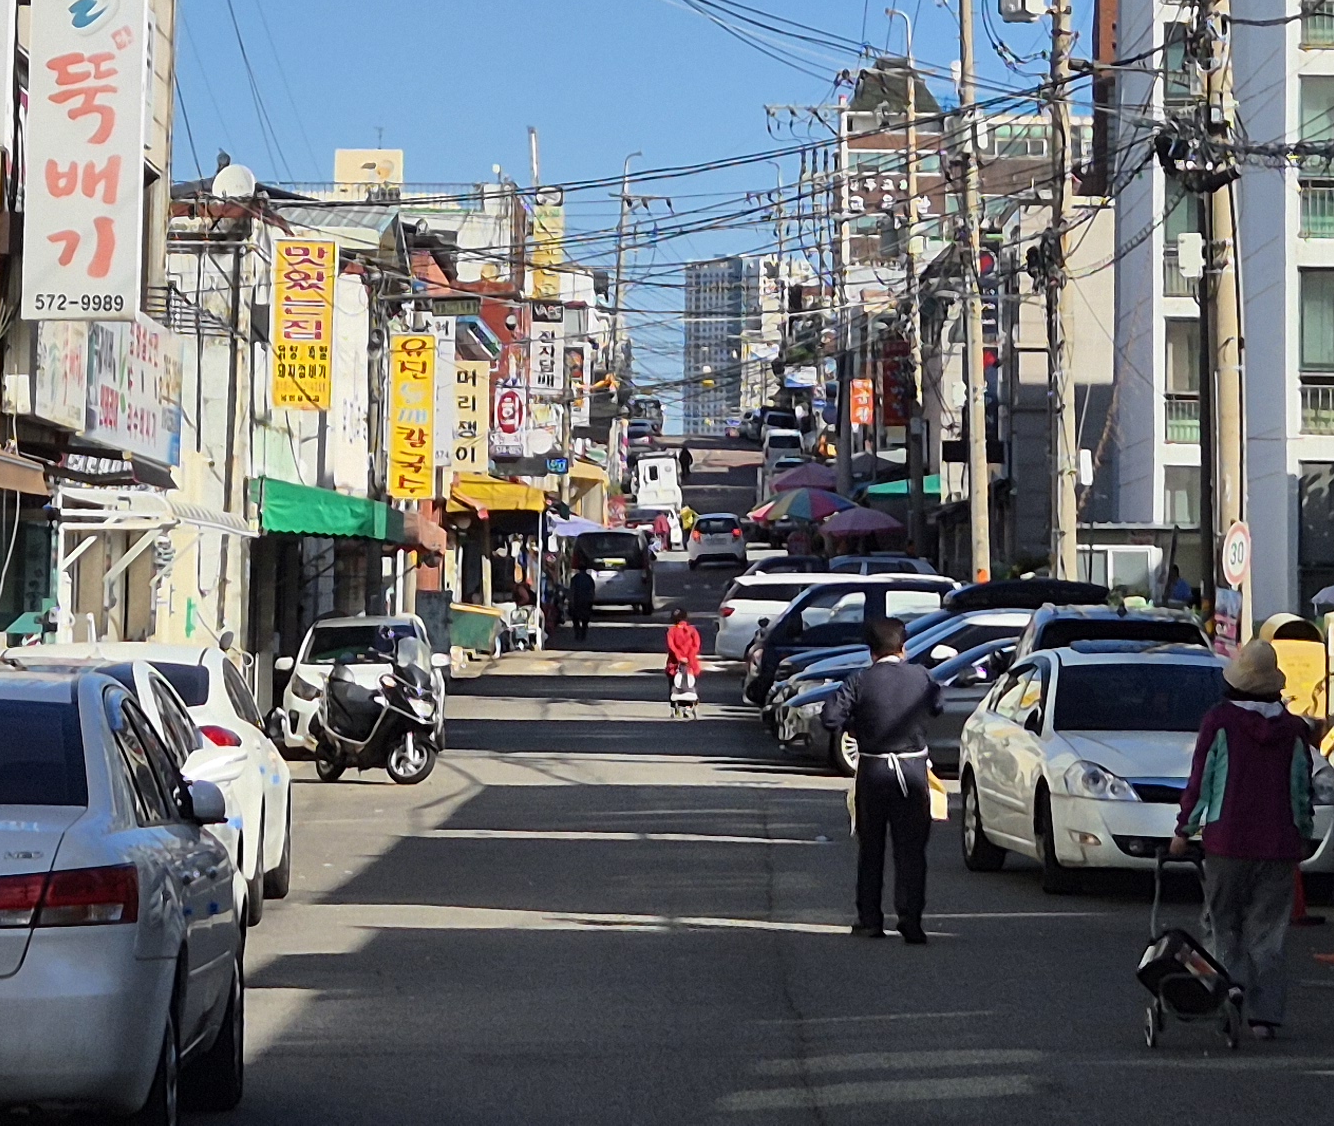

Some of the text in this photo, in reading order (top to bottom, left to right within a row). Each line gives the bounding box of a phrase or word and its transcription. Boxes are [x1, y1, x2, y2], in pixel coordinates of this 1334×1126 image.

[35, 295, 124, 311] 572-9989
[455, 368, 478, 464] 머리쟁이
[1230, 541, 1244, 565] 30
